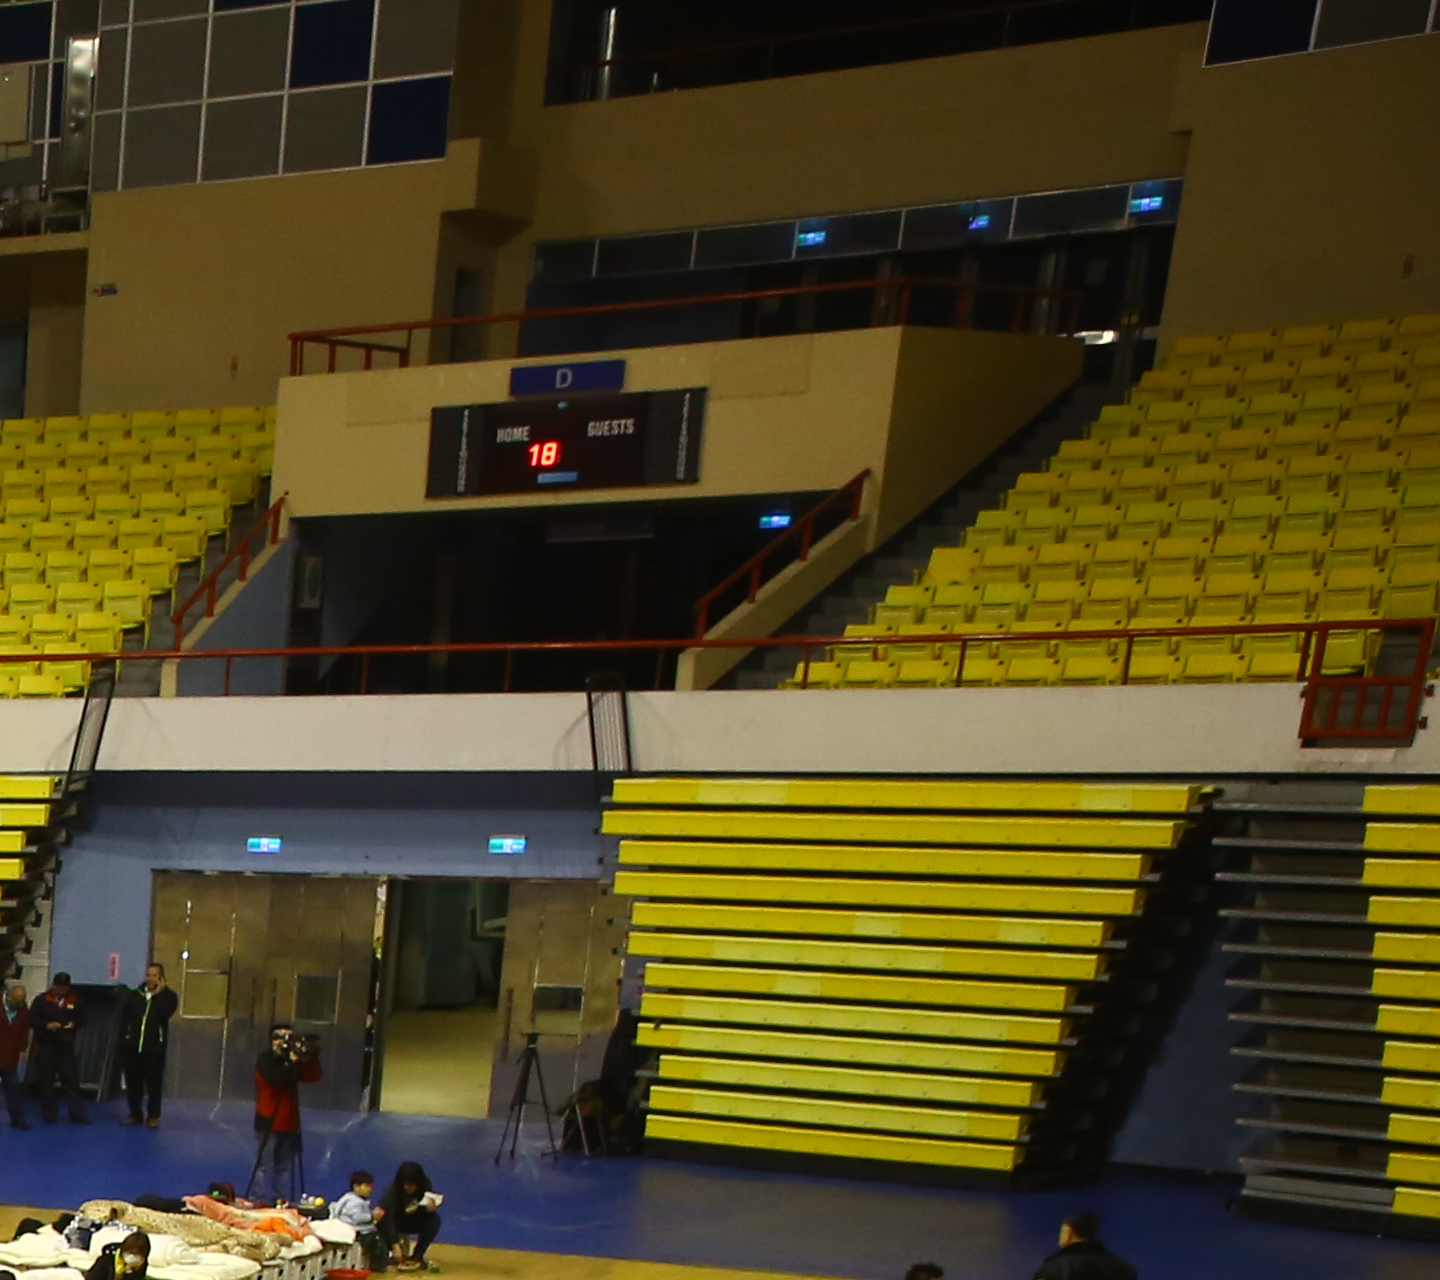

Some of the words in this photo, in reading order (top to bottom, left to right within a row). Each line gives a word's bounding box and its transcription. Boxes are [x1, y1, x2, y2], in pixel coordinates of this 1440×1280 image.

[555, 367, 573, 389] D
[496, 425, 531, 443] HOME
[587, 418, 635, 437] GUESTS
[528, 440, 559, 467] 18
